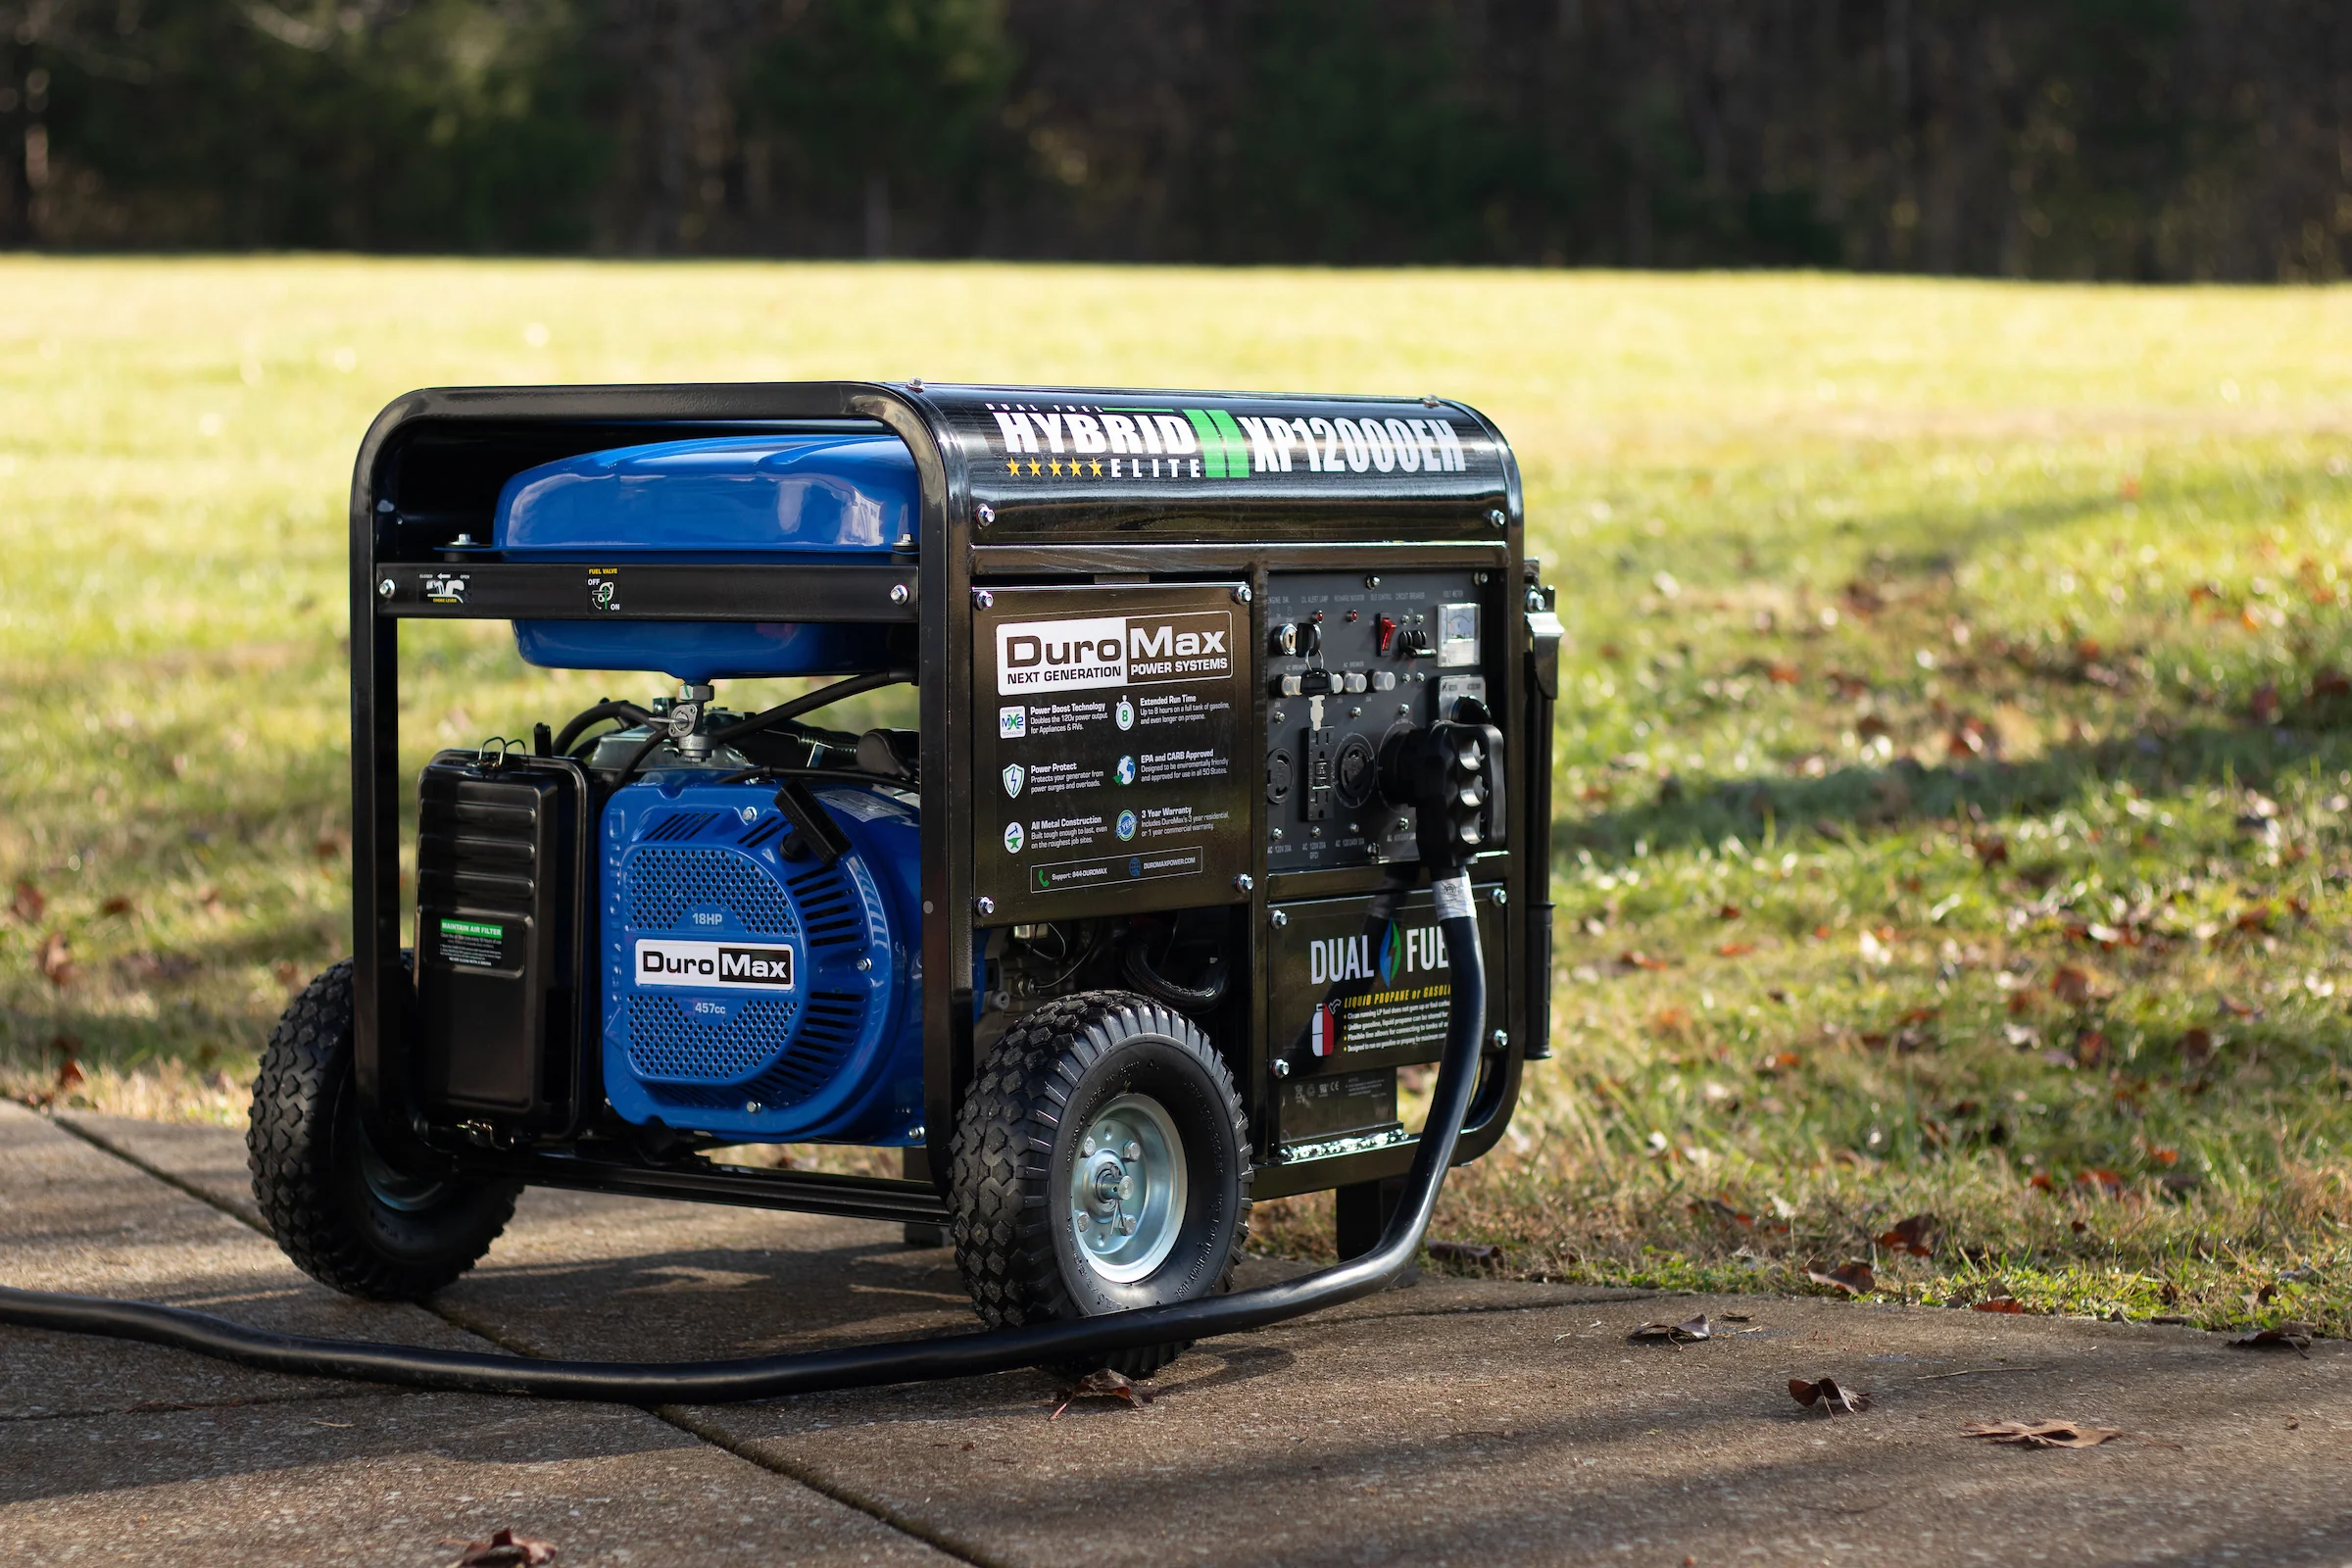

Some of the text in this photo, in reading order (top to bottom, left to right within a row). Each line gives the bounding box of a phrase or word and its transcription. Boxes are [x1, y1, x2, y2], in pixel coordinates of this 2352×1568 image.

[993, 412, 1197, 455] HYBRID
[1237, 417, 1466, 473] XP12000EH
[1110, 458, 1200, 478] ELITE
[1006, 625, 1226, 668] DuroMax
[1007, 658, 1228, 685] NEXT GENERATION POWER SYSTEMS
[1140, 694, 1197, 707] Extended Run Time
[1030, 702, 1106, 715] Power Boost Technology
[1140, 708, 1148, 717] Up
[1193, 703, 1203, 711] tank
[1030, 716, 1050, 725] Doubles
[1075, 714, 1092, 723] power
[1122, 710, 1129, 722] 8
[1162, 715, 1178, 724] longer
[1039, 723, 1066, 735] Appliances
[1141, 749, 1214, 764] EPA and CARB Approved
[1031, 762, 1078, 774] Power Protect
[1141, 763, 1163, 773] Designed
[1031, 775, 1054, 784] Protects
[1054, 774, 1066, 783] your
[1066, 771, 1092, 782] generator
[1141, 774, 1151, 783] and
[1152, 772, 1174, 782] approved
[1031, 785, 1047, 795] power
[1048, 783, 1065, 793] surges
[1142, 806, 1193, 818] 3 Year Warranty
[1031, 815, 1102, 830] All Metal Construction
[1123, 817, 1136, 831] YEAR
[1142, 819, 1161, 828] Includes
[1161, 816, 1188, 826] DuroMax's
[1193, 814, 1203, 823] year
[1031, 831, 1043, 840] Built
[1044, 831, 1058, 840] tough
[1059, 829, 1077, 838] enough
[1152, 828, 1164, 837] year
[1164, 825, 1192, 835] commercial
[1049, 839, 1071, 849] roughest
[1071, 838, 1080, 847] job
[1143, 858, 1196, 870] DUROMAXPOWER.COM
[1052, 867, 1108, 882] Support: 844-DUROMAX
[692, 913, 723, 925] 18HP
[441, 922, 469, 932] MAINTAIN
[481, 927, 502, 936] FILTER
[1311, 926, 1449, 985] DUAL FUE
[643, 951, 787, 979] DuroMax
[1345, 984, 1451, 1008] LIQUID PROPANE or GASOLI
[695, 1003, 726, 1014] 457cc
[1382, 1018, 1395, 1027] liquid
[1374, 1029, 1389, 1038] allows
[1396, 1025, 1421, 1035] connecting
